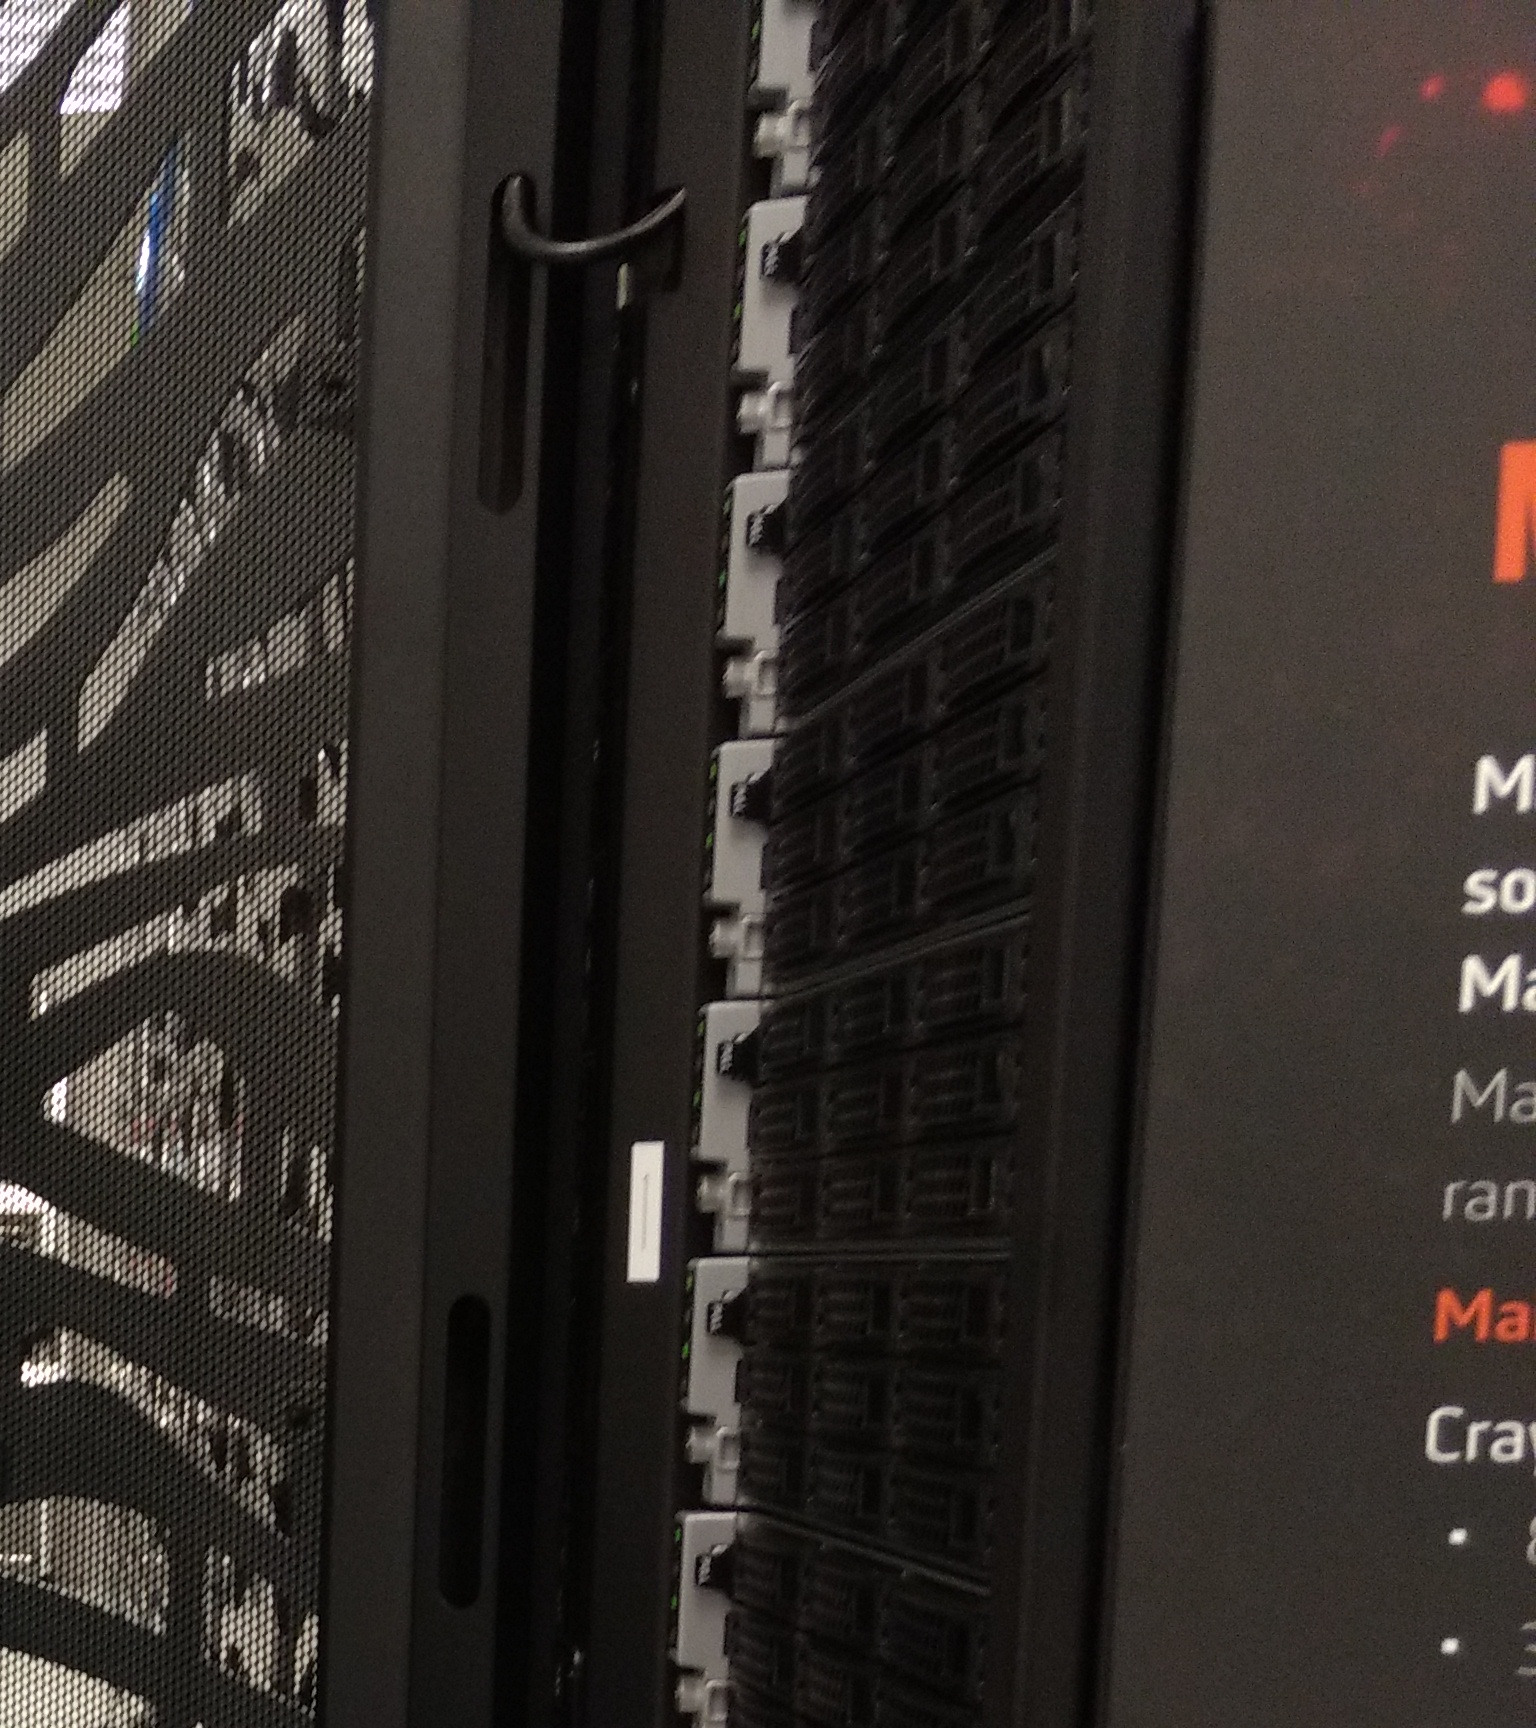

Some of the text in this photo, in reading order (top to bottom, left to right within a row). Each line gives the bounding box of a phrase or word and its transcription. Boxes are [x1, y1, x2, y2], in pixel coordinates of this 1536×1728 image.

[1461, 867, 1536, 914] so
[1451, 1067, 1536, 1124] Ma
[1442, 1178, 1536, 1222] ran
[1432, 1287, 1536, 1344] Ma
[1424, 1405, 1536, 1476] Cra
